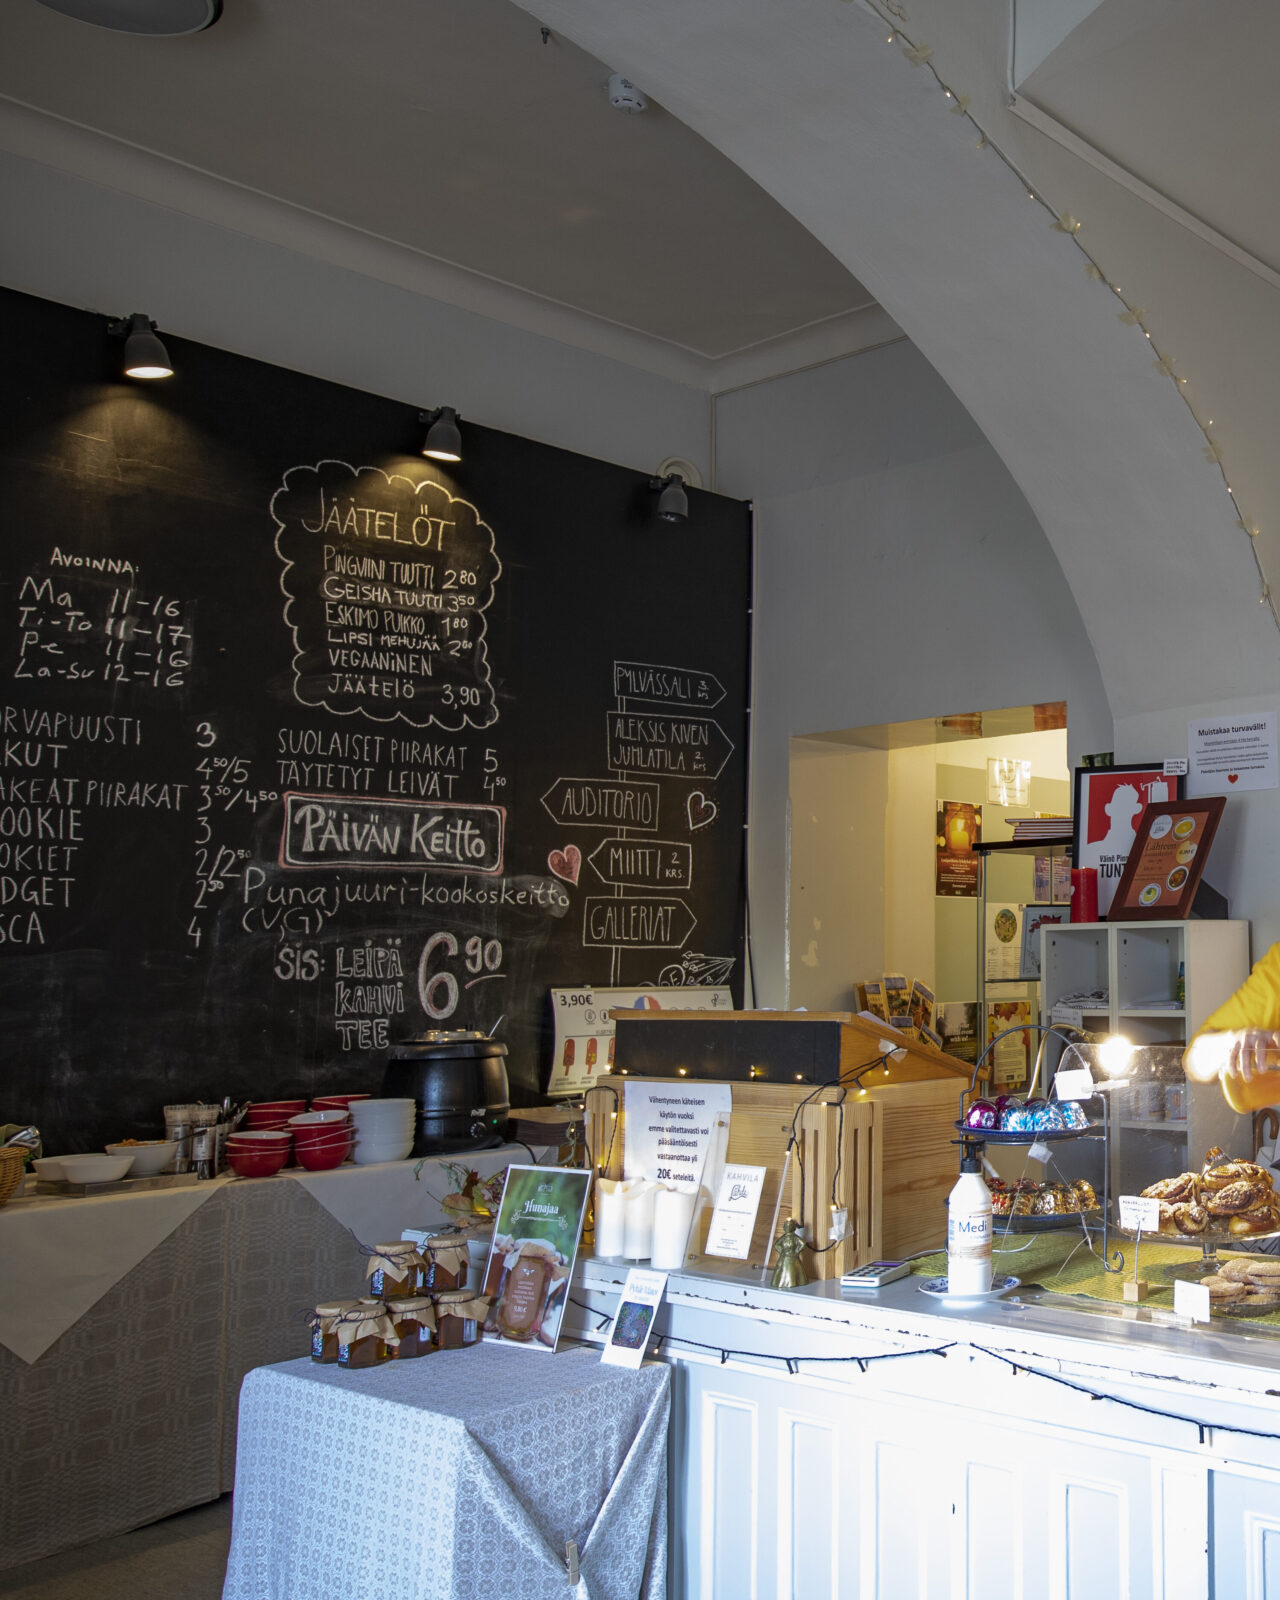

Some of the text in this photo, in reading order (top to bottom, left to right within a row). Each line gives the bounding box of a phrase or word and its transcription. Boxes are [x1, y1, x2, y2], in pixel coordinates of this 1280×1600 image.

[302, 487, 456, 551] JÄÄTELÖT
[390, 562, 434, 590] TUUTTI
[19, 576, 72, 608] Ma
[323, 576, 392, 605] GEISHA
[395, 590, 443, 609] TUUTTI
[326, 602, 379, 630] ESKIMO
[384, 610, 426, 636] PUIKKO
[616, 666, 691, 699] PYLVÄSSALI
[0, 706, 218, 748] RVAPUUSTI 3
[616, 718, 708, 746] ALEKSIS KIVEN
[1198, 728, 1230, 736] Muistakaa
[0, 739, 68, 769] KUT
[278, 728, 499, 774] SUOLAISET PIIRAKAT 5
[614, 744, 686, 772] JUHLATILA
[276, 758, 375, 790] TÄYTETYT
[388, 768, 460, 798] LEIVÄT
[86, 780, 189, 812] PIIRAKAT
[562, 787, 652, 824] AUDITORIO
[195, 816, 212, 845] 3
[672, 852, 680, 864] 2
[188, 916, 202, 948] 4
[590, 906, 677, 942] GALLERIAT
[560, 994, 594, 1008] 3,90€
[336, 1018, 390, 1051] TEE
[648, 1096, 682, 1106] Vähentyneen
[659, 1110, 694, 1120] käytön vuoksi
[666, 1126, 700, 1134] valitettavasti
[657, 1154, 690, 1162] vastaanottaa
[657, 1168, 672, 1180] 20€
[522, 1199, 559, 1216] Hunajaa
[958, 1220, 987, 1232] Medi
